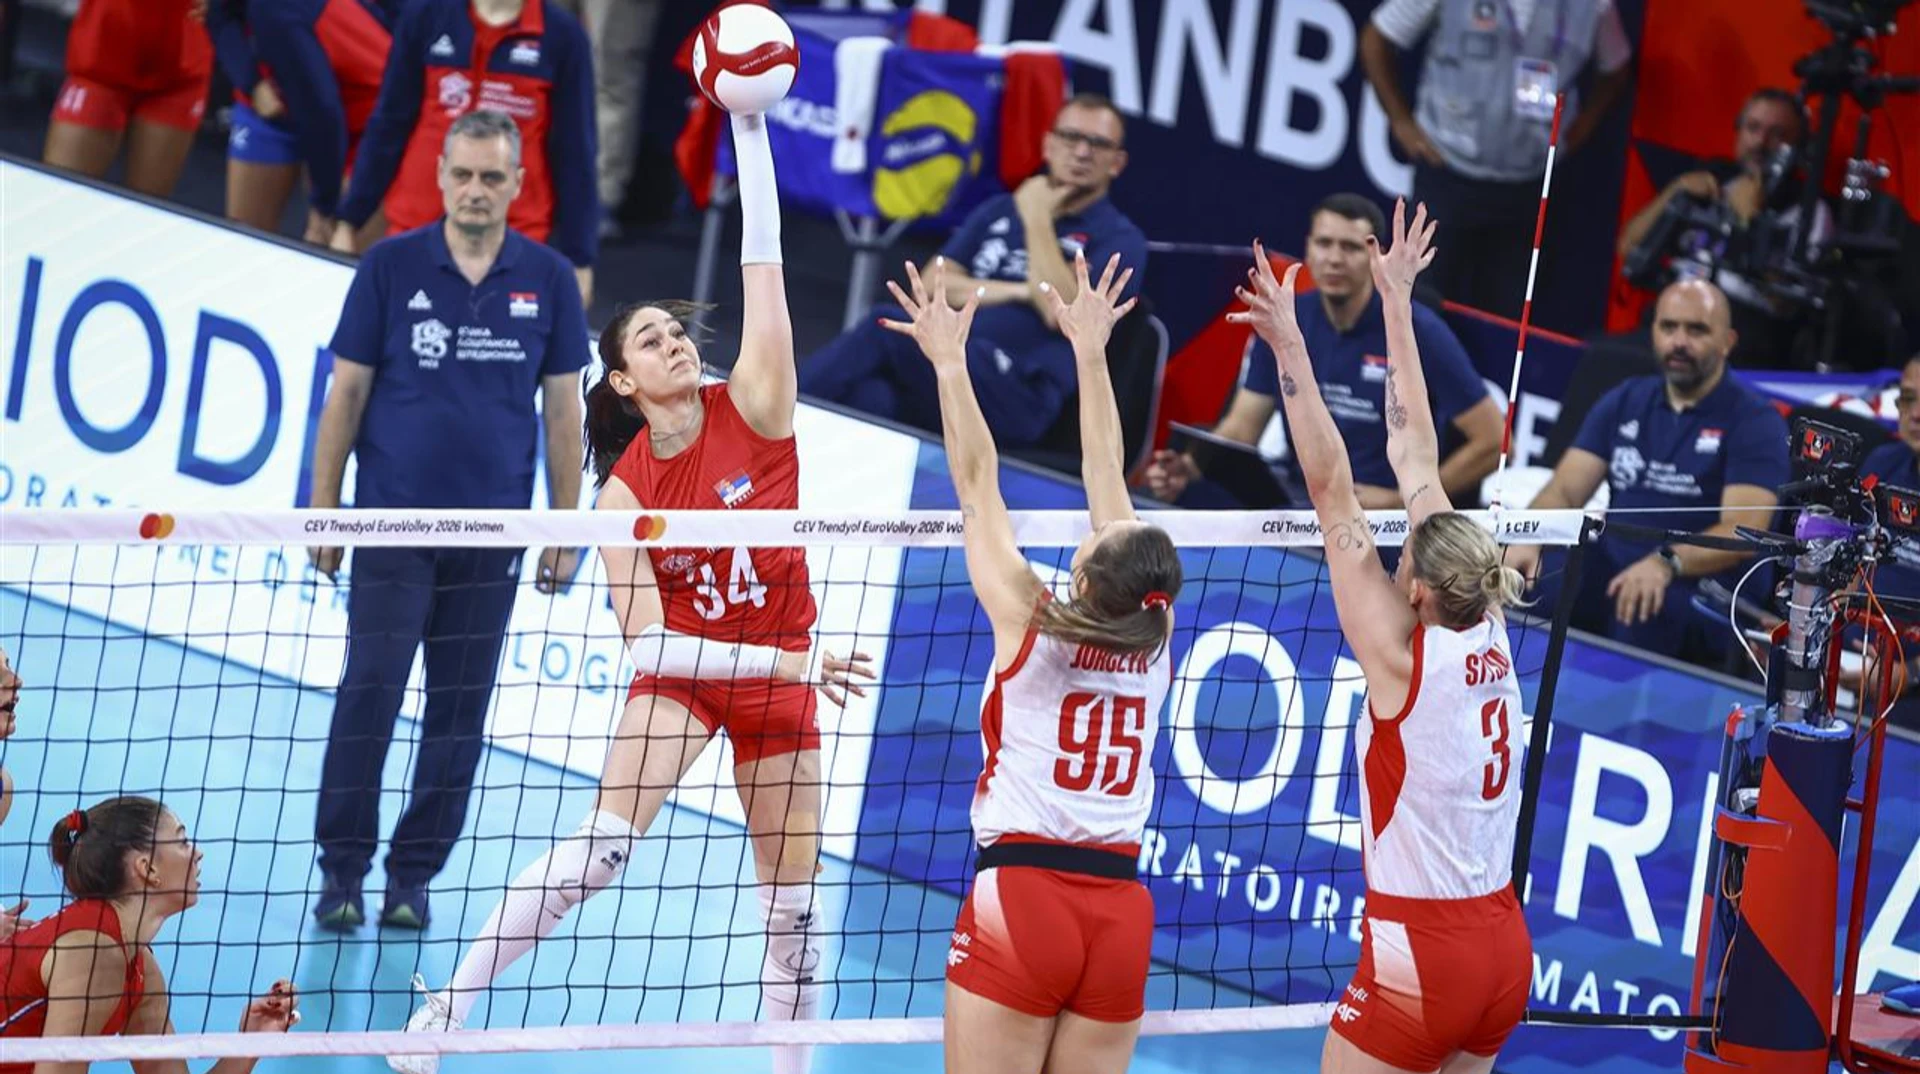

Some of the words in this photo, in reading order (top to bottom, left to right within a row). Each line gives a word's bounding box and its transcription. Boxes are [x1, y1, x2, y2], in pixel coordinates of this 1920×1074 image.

[304, 520, 327, 533] CEV
[330, 519, 376, 535] Trendyol
[377, 519, 433, 535] EuroVolley
[435, 520, 461, 533] 2026
[464, 520, 504, 533] Women
[793, 520, 815, 533] CEV
[817, 520, 861, 536] Trendyol
[862, 520, 917, 536] EuroVolley
[918, 520, 944, 534] 2026
[946, 521, 964, 534] Wo
[1262, 520, 1284, 533] CEV
[1382, 520, 1408, 533] 2026
[1513, 520, 1541, 533] CEV
[693, 546, 768, 620] 34
[1053, 691, 1147, 797] 95
[1481, 697, 1511, 801] 3
